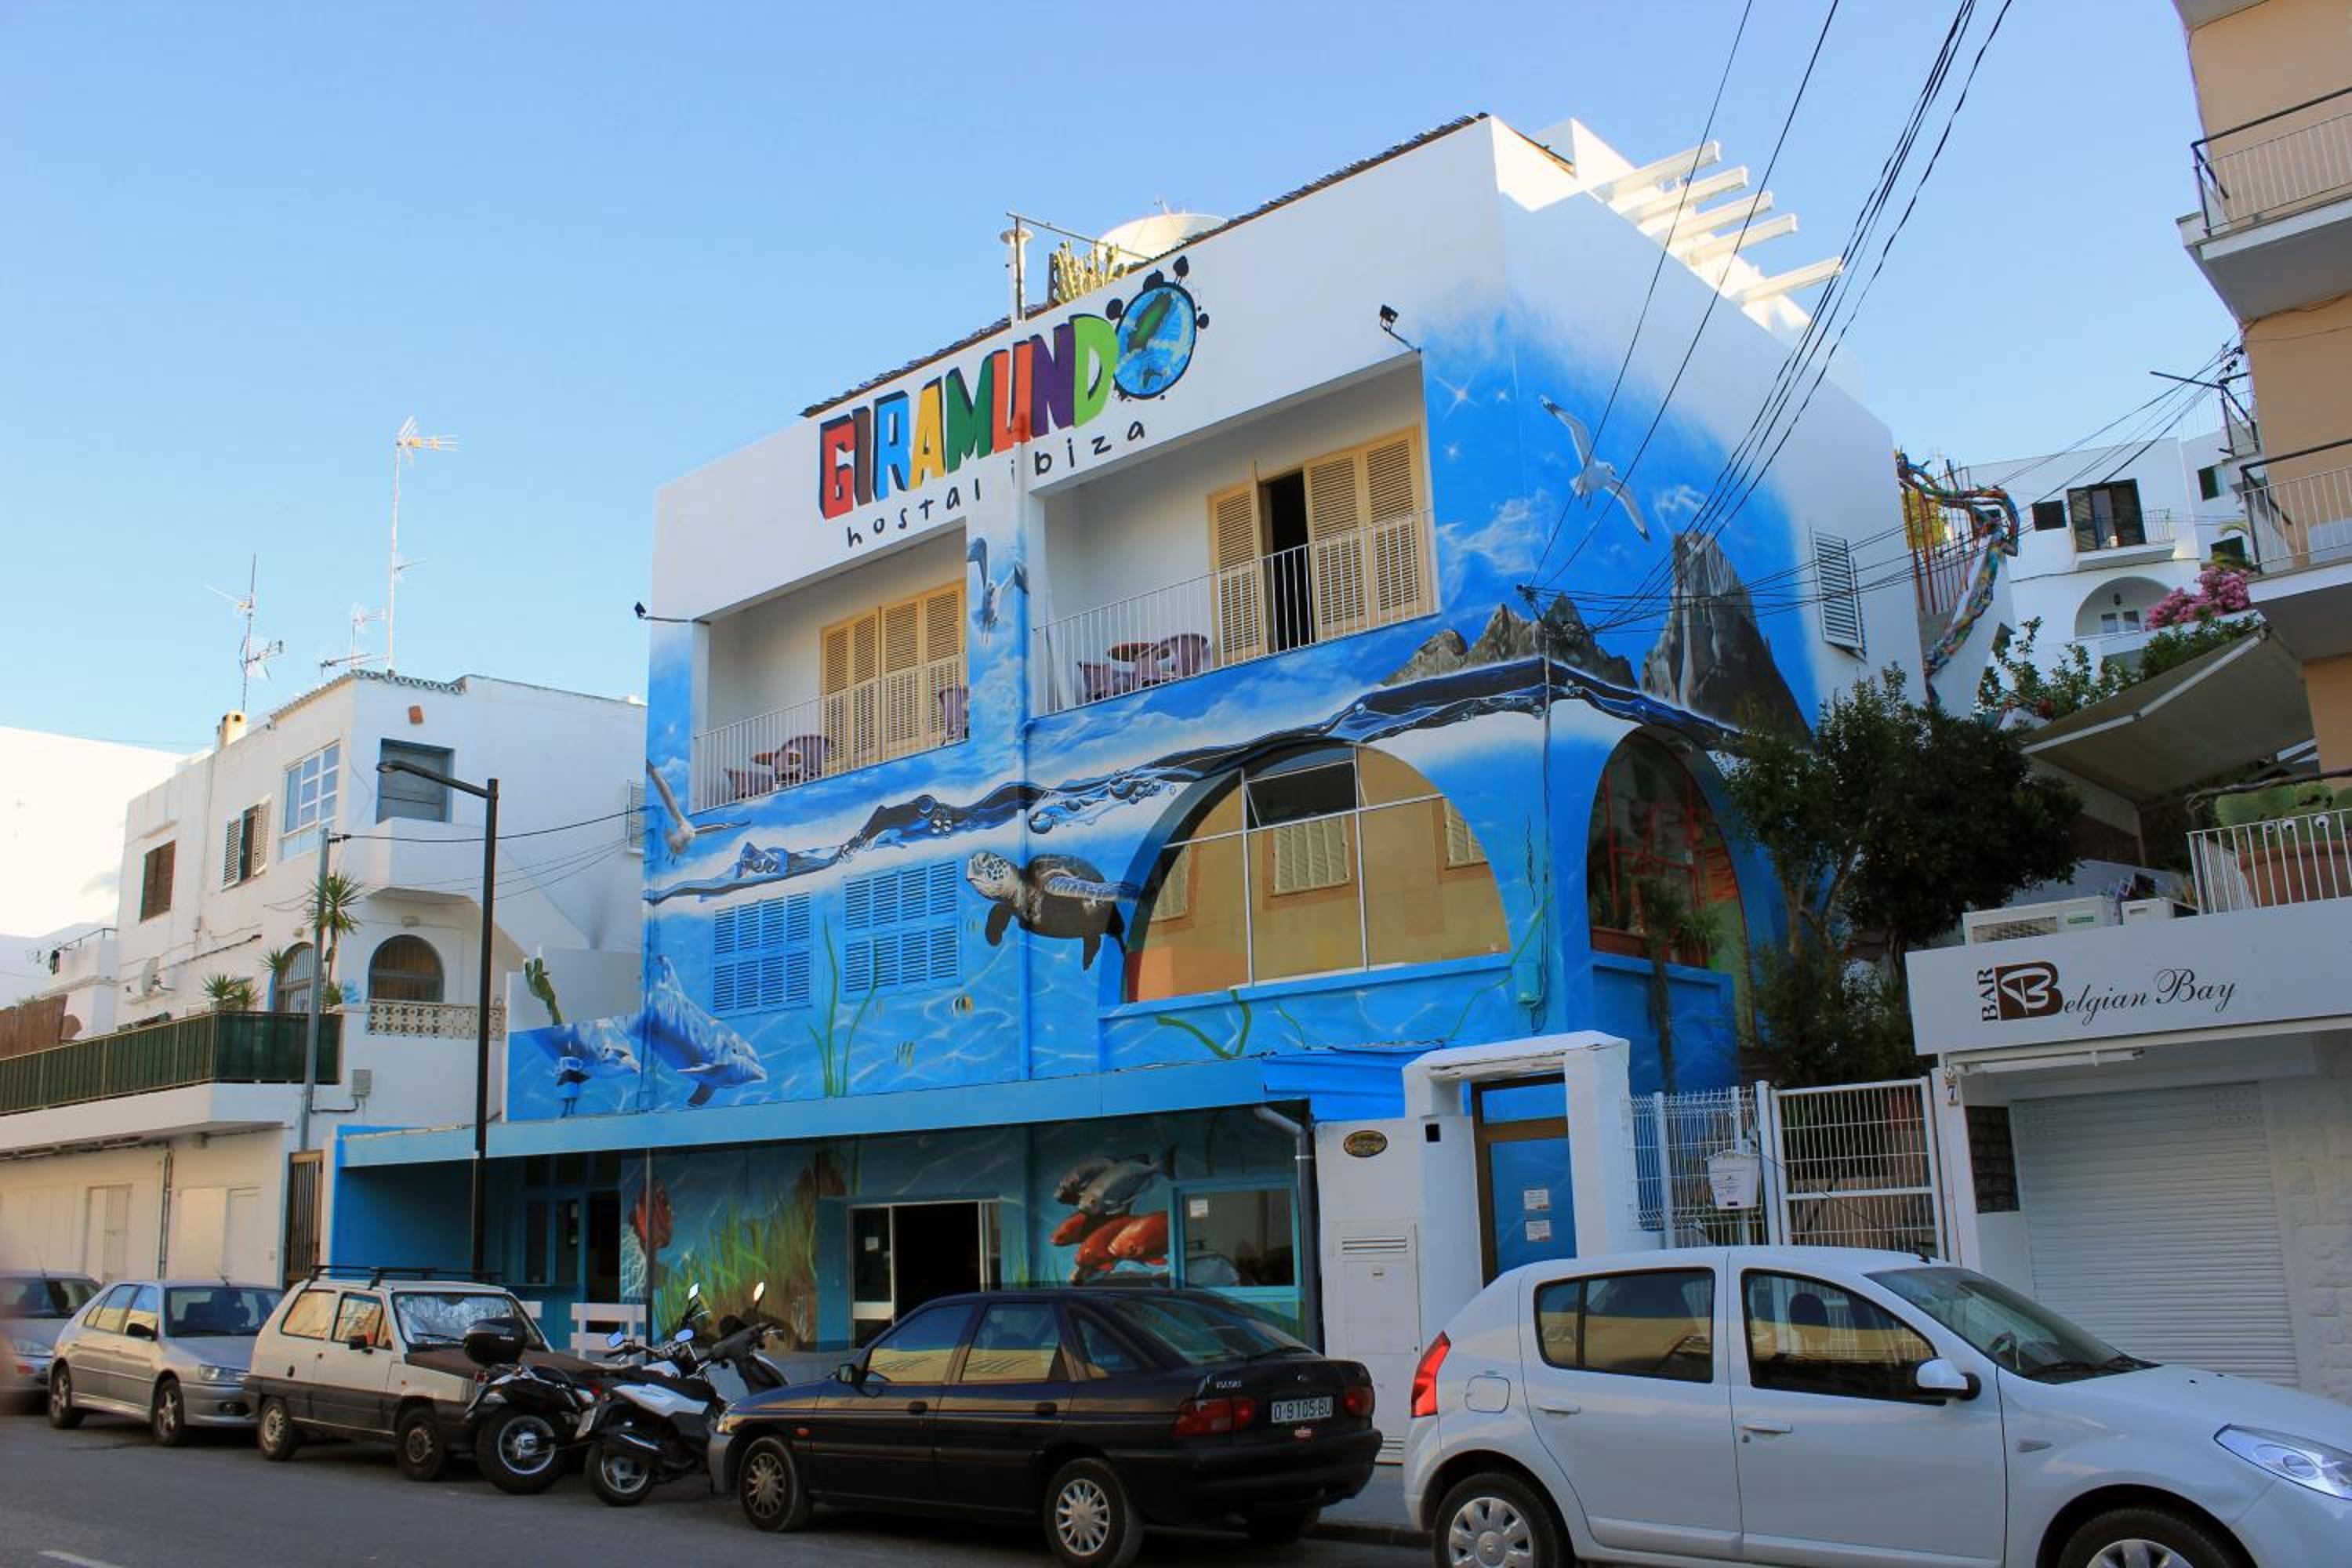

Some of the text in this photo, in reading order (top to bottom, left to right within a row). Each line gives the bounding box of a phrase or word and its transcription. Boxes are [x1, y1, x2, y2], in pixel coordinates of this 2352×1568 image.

[847, 420, 1145, 547] hostal ibiza
[1976, 967, 1998, 1022] BAR
[1994, 961, 2236, 1026] Belgian Bay
